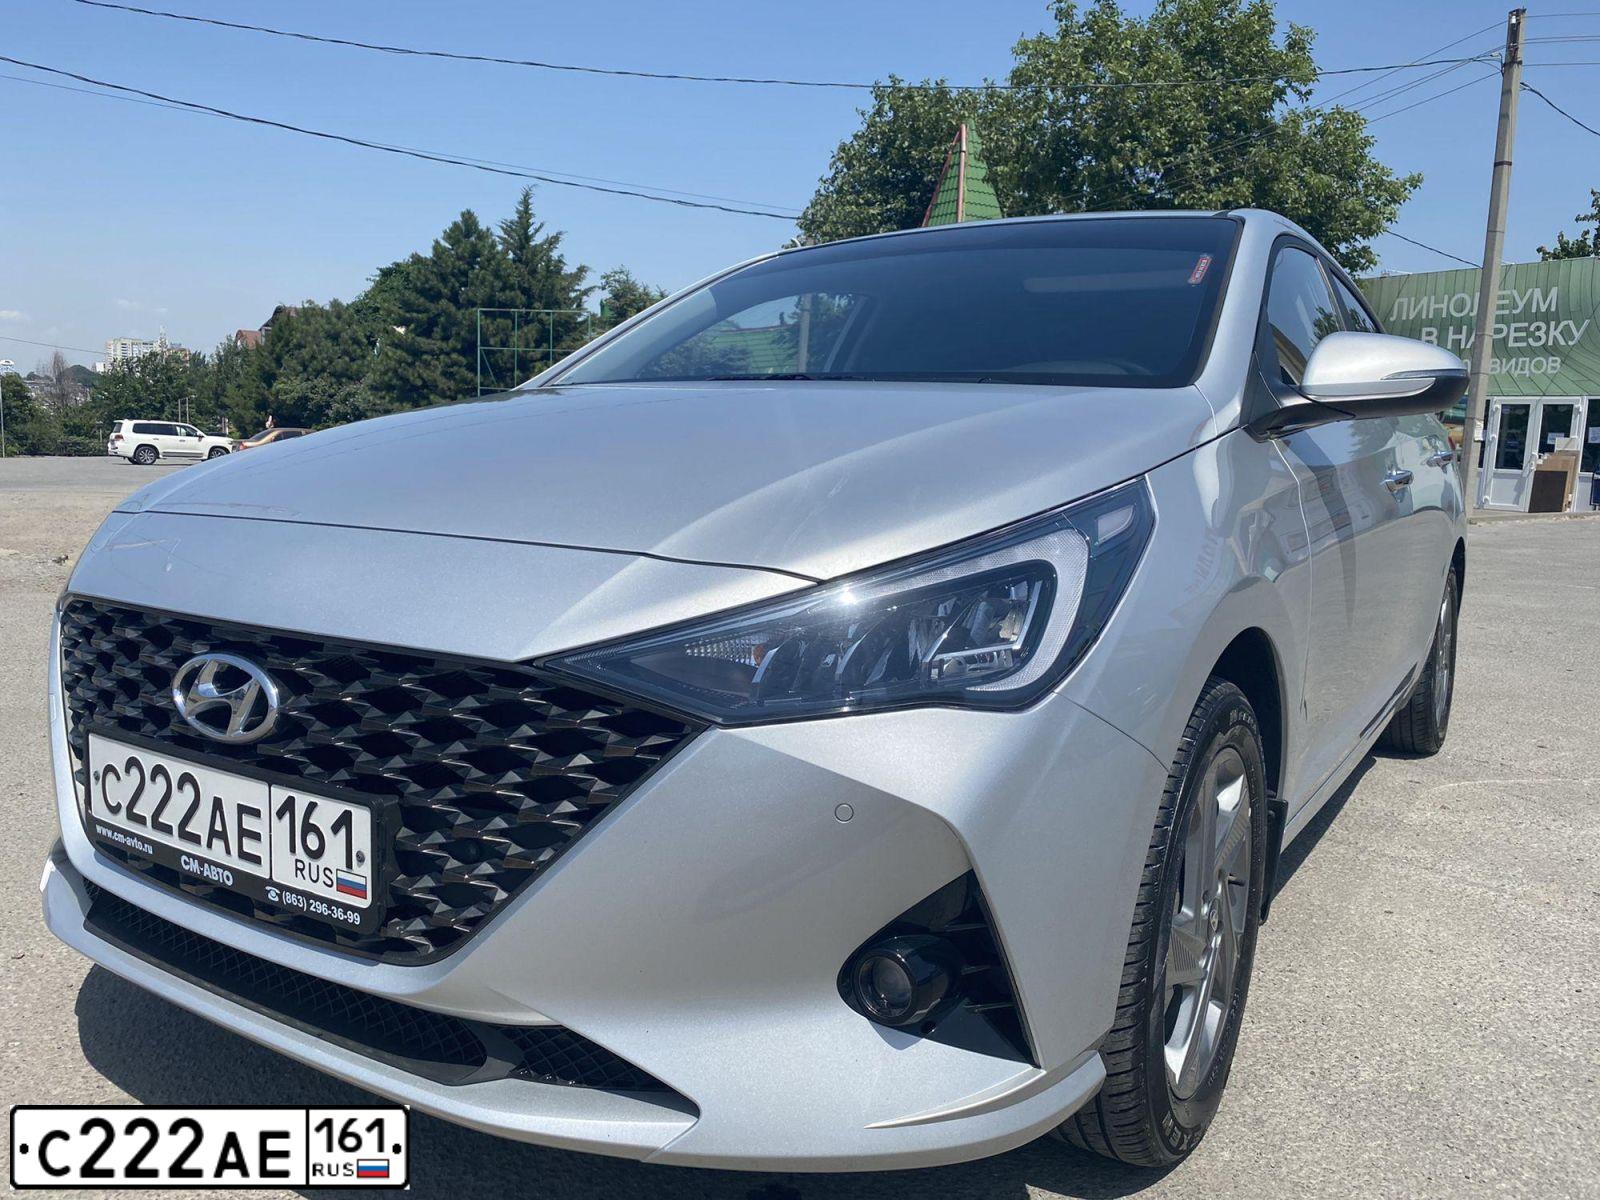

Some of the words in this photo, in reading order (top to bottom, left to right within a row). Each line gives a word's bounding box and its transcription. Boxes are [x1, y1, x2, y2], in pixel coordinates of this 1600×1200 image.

[1420, 327, 1439, 347] В
[1488, 356, 1562, 378] ВИДОВ
[95, 824, 153, 855] www.cm-avto.ru
[275, 795, 353, 870] 161
[180, 855, 233, 886] СМ-АВТО
[295, 858, 334, 888] RUS
[282, 890, 307, 911] (863)
[309, 899, 361, 925] 296-36-99
